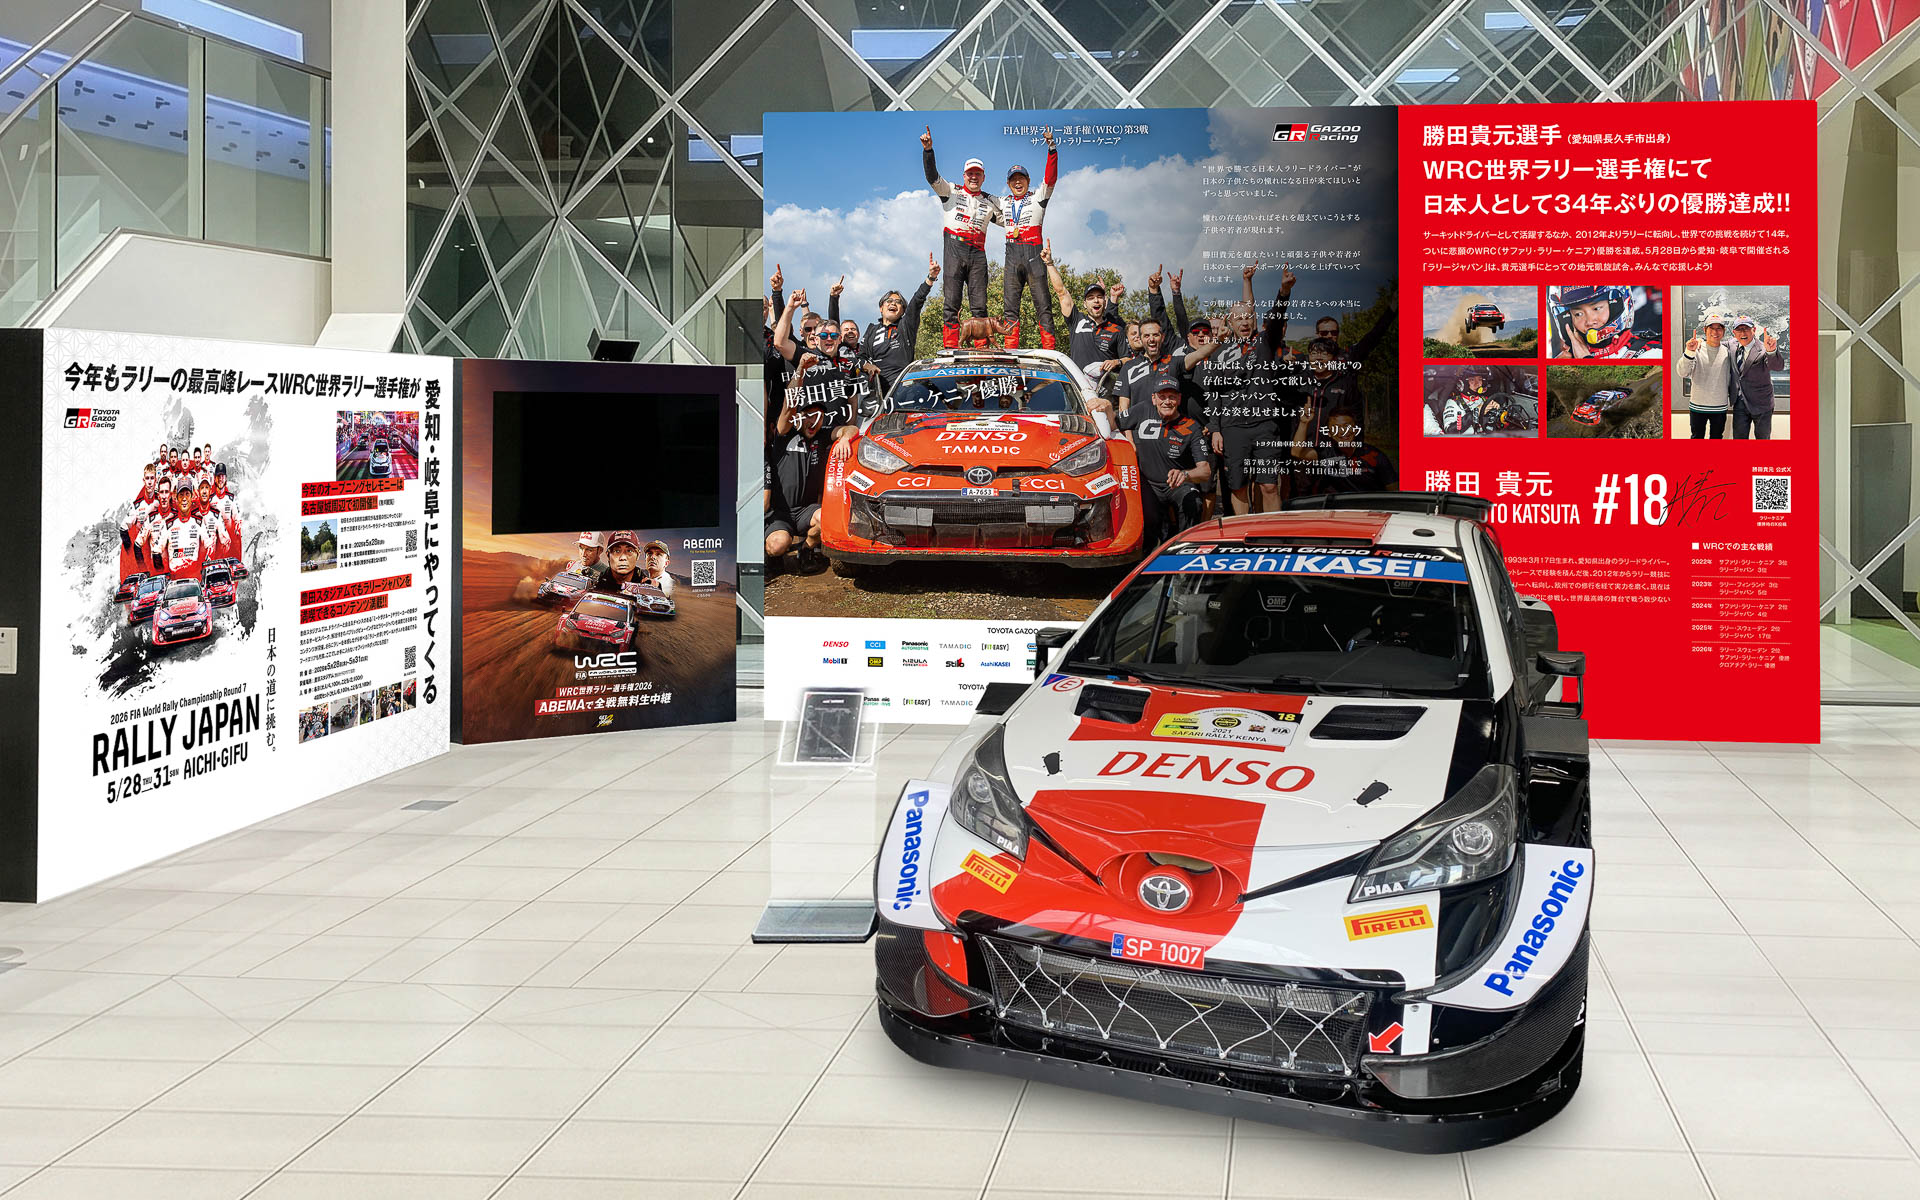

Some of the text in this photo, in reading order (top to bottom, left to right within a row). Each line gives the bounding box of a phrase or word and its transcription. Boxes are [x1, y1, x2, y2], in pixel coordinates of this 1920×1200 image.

[1274, 130, 1305, 141] GR
[1309, 133, 1358, 143] Racing
[1310, 124, 1361, 133] GAZOO
[1423, 125, 1672, 146] 勝田貴元選手 (愛知県長久手市出身)
[1423, 158, 1712, 180] WRC世界ラリー選手権にて
[1203, 189, 1278, 198] ずっと思っていました。
[1424, 192, 1791, 215] 日本人として34年ぶりの優勝達成!!
[1203, 226, 1284, 235] 子供や若者が現れます。
[1203, 275, 1235, 283] くれます。
[63, 361, 423, 400] 今年もラリーの最高峰レースWRC世界ラリー選手権が
[784, 375, 870, 408] 勝田貴元
[64, 415, 90, 429] GR
[90, 422, 116, 430] Racing
[1319, 425, 1362, 436] モリゾウ
[935, 431, 1028, 442] DENSO
[941, 445, 1021, 455] TAMADIC
[301, 479, 403, 497] 今年のオープニングセレモニーは
[968, 488, 992, 496] A-7653
[1496, 470, 1553, 497] 貴元
[1592, 473, 1668, 526] #18
[1513, 503, 1580, 525] KATSUTA
[423, 379, 440, 705] 愛知・岐阜にやってくる
[683, 538, 722, 549] ABEMA
[1218, 547, 1445, 562] TOYOTA GAZOO Racing
[1179, 554, 1427, 577] AsahiKASEI
[300, 575, 411, 606] 豊田スタジアムでもラリージャパンを
[574, 651, 637, 669] WRC
[266, 627, 277, 752] 日本の道に挑む。
[110, 683, 247, 726] 2026 FIA World Rally Championship Round 7
[538, 692, 672, 714] ABEMAで全戦無料生中継
[1278, 713, 1296, 721] 18
[92, 693, 260, 777] RALLY JAPAN
[1206, 732, 1234, 740] RALLY
[1235, 735, 1268, 743] KENYA
[1096, 750, 1316, 793] DENSO
[106, 773, 142, 804] 5/28
[893, 789, 930, 911] Panasonic
[996, 835, 1020, 855] PIAA
[963, 853, 1012, 889] PIRELLI
[1363, 881, 1405, 897] PIAA
[1352, 908, 1427, 937] PIRELLI
[1483, 858, 1586, 998] Panasonic
[1125, 938, 1202, 965] SP 1007
